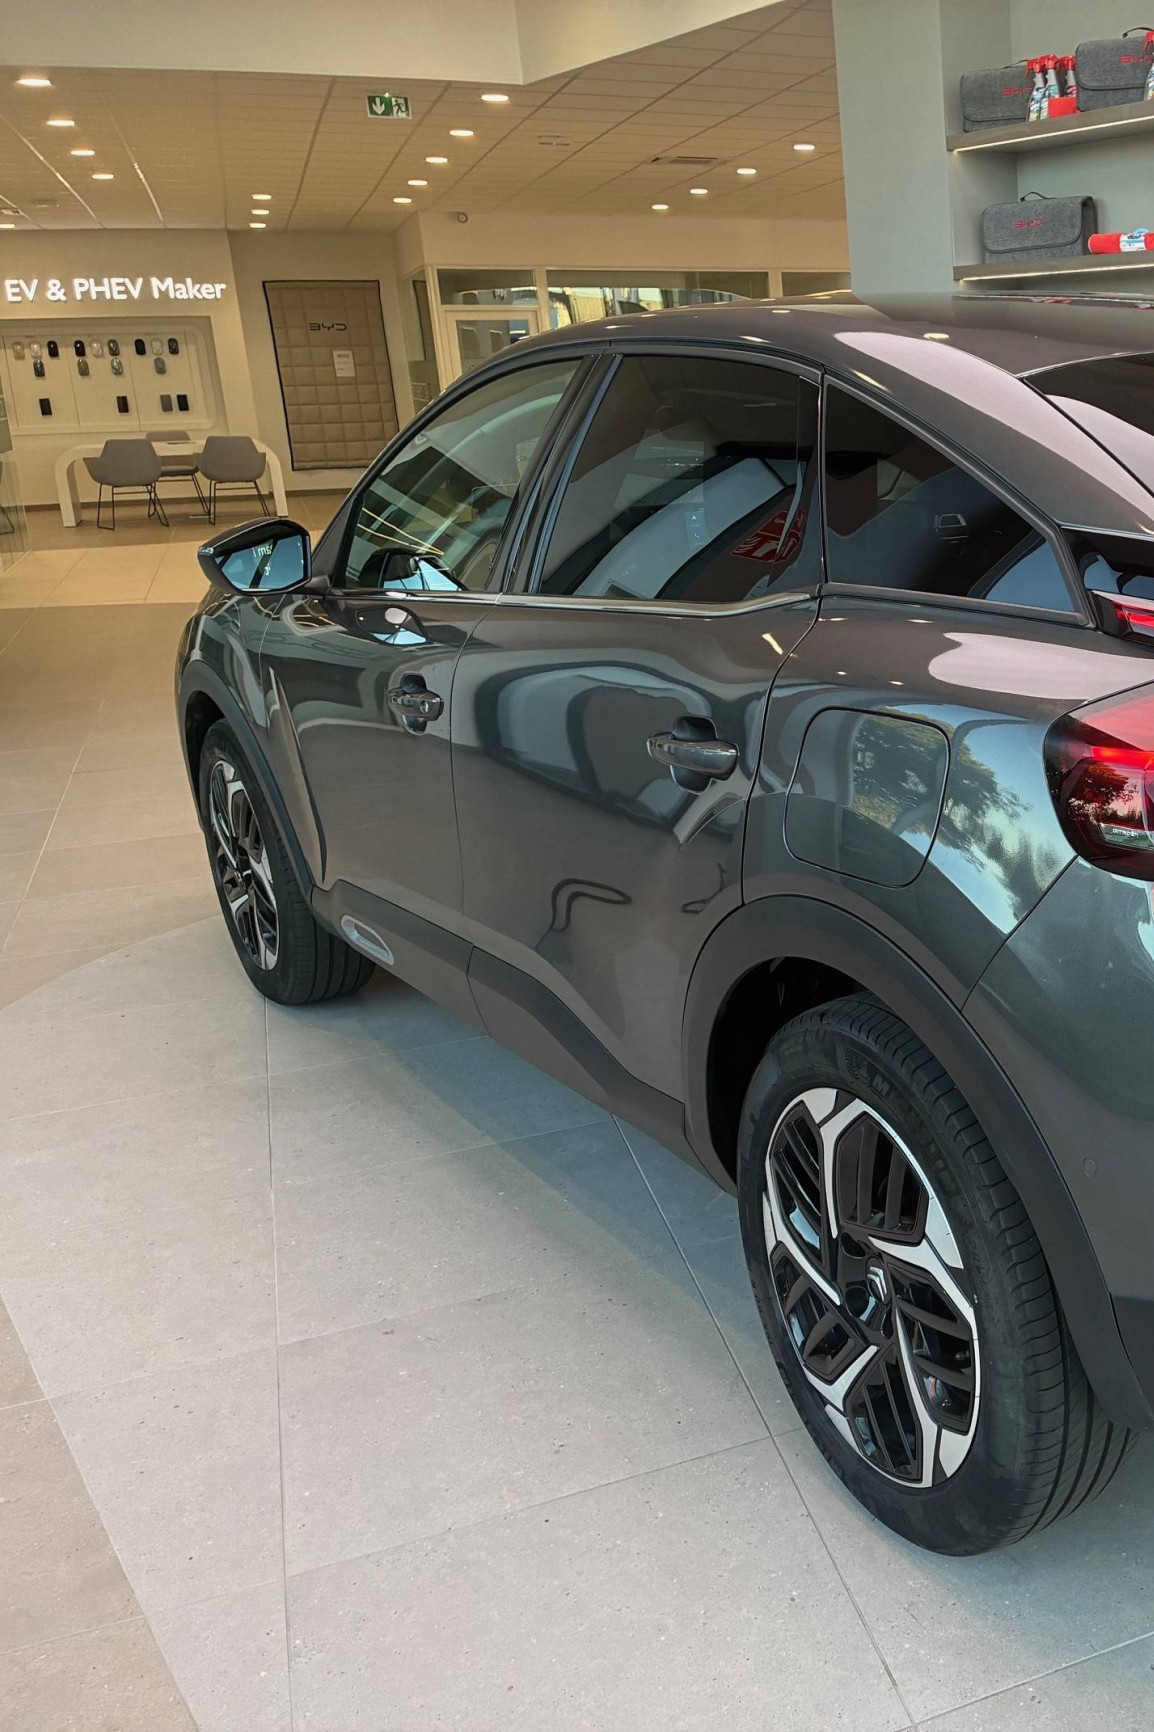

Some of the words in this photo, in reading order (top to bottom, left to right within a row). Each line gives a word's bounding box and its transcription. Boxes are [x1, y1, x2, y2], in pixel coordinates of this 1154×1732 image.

[1014, 216, 1044, 230] BYD
[5, 279, 38, 301] EV
[47, 279, 67, 301] &
[73, 277, 143, 300] PHEV
[150, 277, 226, 300] Maker
[309, 323, 347, 331] BYD
